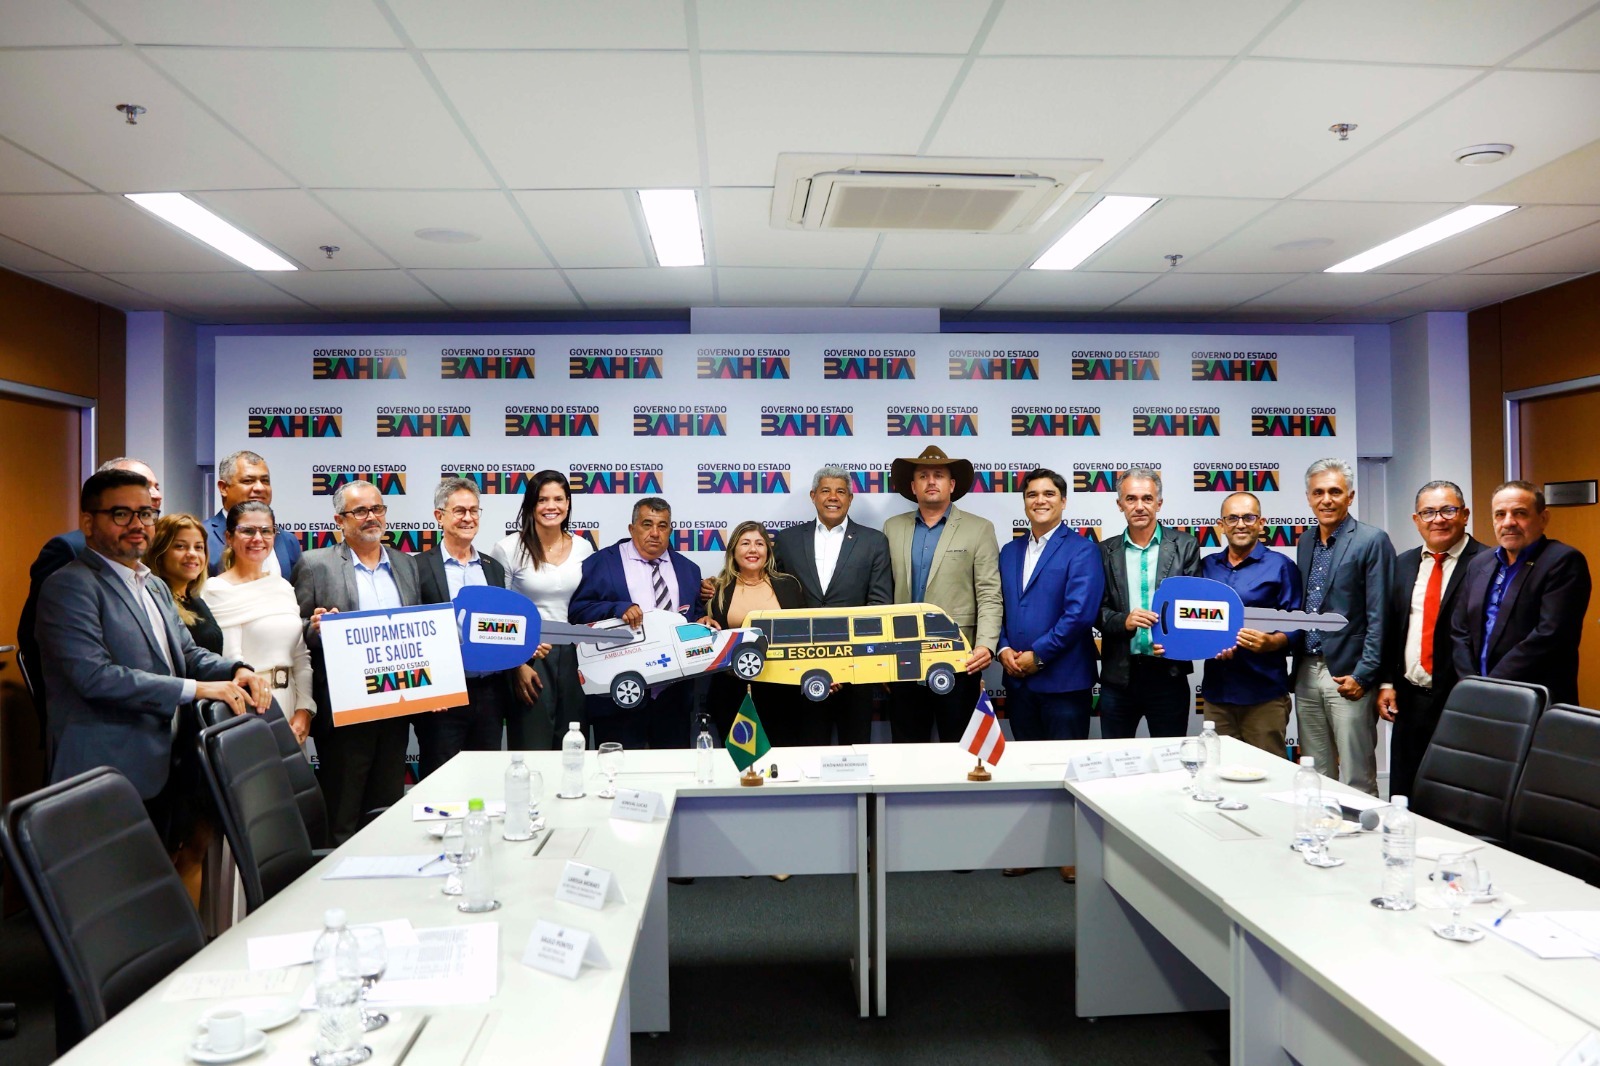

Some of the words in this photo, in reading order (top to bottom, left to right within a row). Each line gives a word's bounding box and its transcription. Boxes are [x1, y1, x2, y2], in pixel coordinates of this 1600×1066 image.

[313, 349, 357, 357] GOVERNO
[358, 349, 371, 357] DO
[373, 349, 407, 357] ESTADO
[441, 348, 485, 356] GOVERNO
[486, 348, 500, 356] DO
[501, 348, 536, 356] ESTADO
[569, 348, 613, 356] GOVERNO
[614, 348, 628, 356] DO
[629, 348, 664, 356] ESTADO
[697, 348, 740, 357] GOVERNO
[742, 348, 756, 357] DO
[757, 348, 791, 357] ESTADO
[823, 349, 867, 357] GOVERNO
[868, 349, 881, 357] DO
[883, 349, 916, 357] ESTADO
[948, 350, 991, 358] GOVERNO
[992, 350, 1005, 358] DO
[1007, 350, 1040, 358] ESTADO
[313, 357, 407, 379] BAHIA
[441, 357, 536, 379] BAHIA
[569, 357, 664, 379] BAHIA
[697, 357, 791, 379] BAHIA
[823, 357, 916, 380] BAHIA
[948, 358, 1040, 381] BAHIA
[1071, 358, 1160, 381] BAHIA
[1191, 359, 1278, 382] BAHIA
[248, 407, 292, 415] GOVERNO
[294, 407, 308, 415] DO
[309, 407, 343, 415] ESTADO
[376, 406, 421, 414] GOVERNO
[422, 406, 436, 414] DO
[437, 406, 471, 414] ESTADO
[504, 406, 549, 414] GOVERNO
[550, 406, 564, 414] DO
[565, 406, 600, 414] ESTADO
[632, 406, 676, 414] GOVERNO
[678, 406, 692, 414] DO
[693, 406, 727, 414] ESTADO
[760, 406, 804, 414] GOVERNO
[805, 406, 819, 414] DO
[820, 406, 854, 414] ESTADO
[886, 406, 930, 414] GOVERNO
[931, 406, 944, 414] DO
[946, 406, 979, 414] ESTADO
[1011, 406, 1053, 414] GOVERNO
[1054, 406, 1067, 414] DO
[1068, 406, 1101, 414] ESTADO
[1132, 406, 1174, 414] GOVERNO
[1175, 406, 1188, 414] DO
[1189, 406, 1220, 414] ESTADO
[248, 415, 343, 437] BAHIA
[376, 414, 471, 437] BAHIA
[504, 414, 600, 437] BAHIA
[632, 414, 727, 437] BAHIA
[760, 414, 854, 437] BAHIA
[886, 414, 979, 437] BAHIA
[1011, 414, 1101, 437] BAHIA
[1132, 414, 1220, 437] BAHIA
[1250, 415, 1337, 437] BAHIA
[312, 465, 356, 473] GOVERNO
[357, 465, 371, 473] DO
[373, 465, 407, 473] ESTADO
[440, 464, 484, 472] GOVERNO
[486, 464, 500, 472] DO
[501, 464, 536, 472] ESTADO
[569, 463, 613, 471] GOVERNO
[614, 463, 628, 471] DO
[629, 463, 664, 471] ESTADO
[697, 463, 741, 471] GOVERNO
[742, 463, 756, 471] DO
[757, 463, 791, 471] ESTADO
[869, 463, 882, 471] DO
[994, 463, 1007, 471] DO
[1008, 463, 1041, 471] ESTADO
[569, 471, 664, 494] BAHIA
[697, 471, 791, 494] BAHIA
[1193, 470, 1280, 492] BAHIA
[293, 523, 307, 531] DO
[422, 522, 436, 530] DO
[679, 521, 693, 529] DO
[694, 521, 728, 529] ESTADO
[1177, 518, 1190, 526] DO
[1294, 517, 1307, 525] DO
[1179, 607, 1225, 620] BAHIA
[345, 620, 437, 645] EQUIPAMENTOS
[477, 621, 519, 634] BAHIA
[366, 646, 382, 664] DE
[385, 641, 423, 662] SAÚDE
[788, 645, 854, 659] ESCOLAR
[364, 665, 396, 676] GOVERNO
[396, 663, 406, 671] DO
[406, 660, 430, 669] ESTADO
[645, 660, 657, 668] SUS
[365, 667, 432, 695] BAHIA
